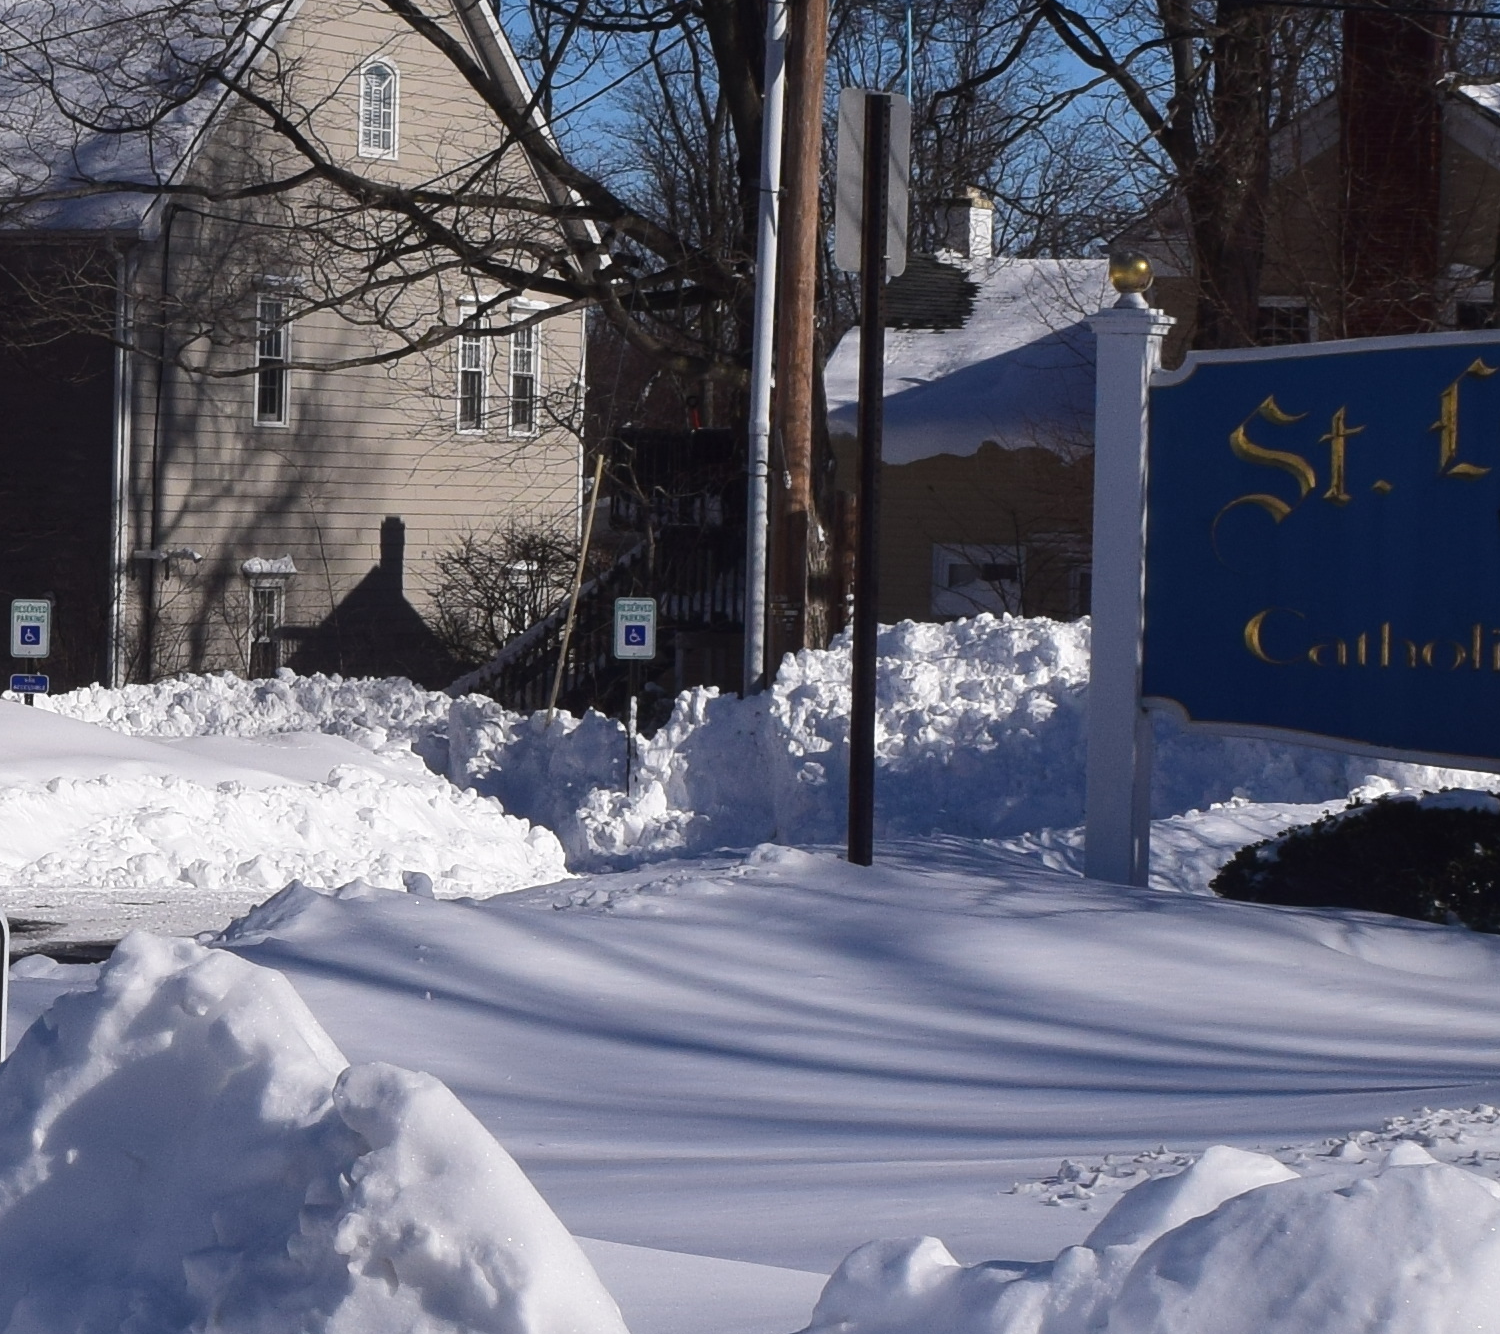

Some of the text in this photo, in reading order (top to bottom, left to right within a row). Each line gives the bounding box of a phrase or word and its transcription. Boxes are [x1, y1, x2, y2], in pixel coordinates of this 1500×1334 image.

[1212, 395, 1393, 565] St.
[16, 615, 45, 623] PARKING
[620, 614, 651, 622] PARKING
